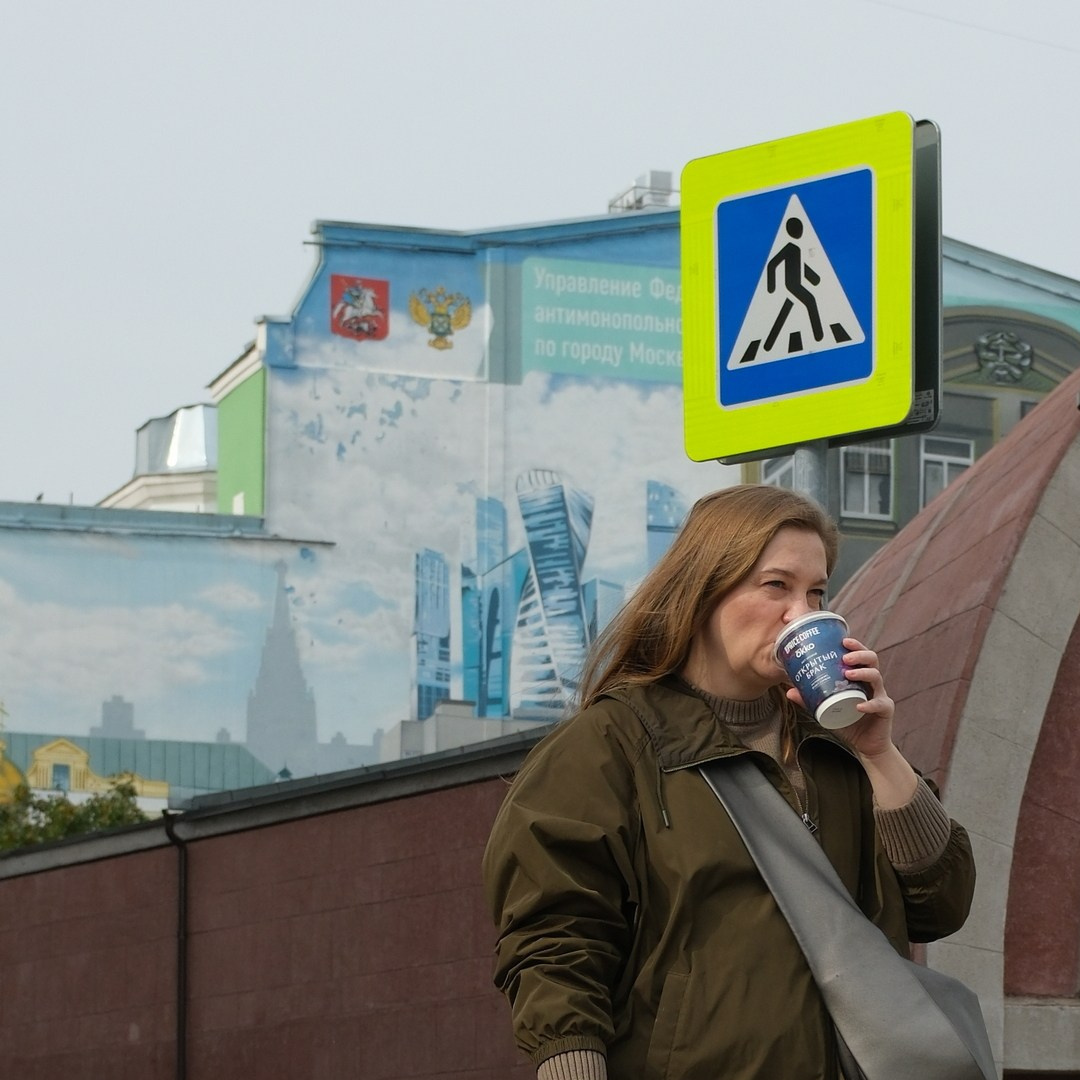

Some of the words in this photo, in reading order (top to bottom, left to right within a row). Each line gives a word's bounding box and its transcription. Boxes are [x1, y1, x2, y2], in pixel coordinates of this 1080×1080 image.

[535, 267, 642, 298] Управление
[650, 277, 682, 303] Фед
[535, 306, 682, 333] антимонопольно
[536, 339, 556, 357] по
[562, 342, 623, 367] городу
[629, 342, 683, 367] Москв
[799, 627, 821, 641] COFFEE
[795, 650, 838, 682] ОТКРЫТЫЙ
[806, 664, 827, 679] БРАК
